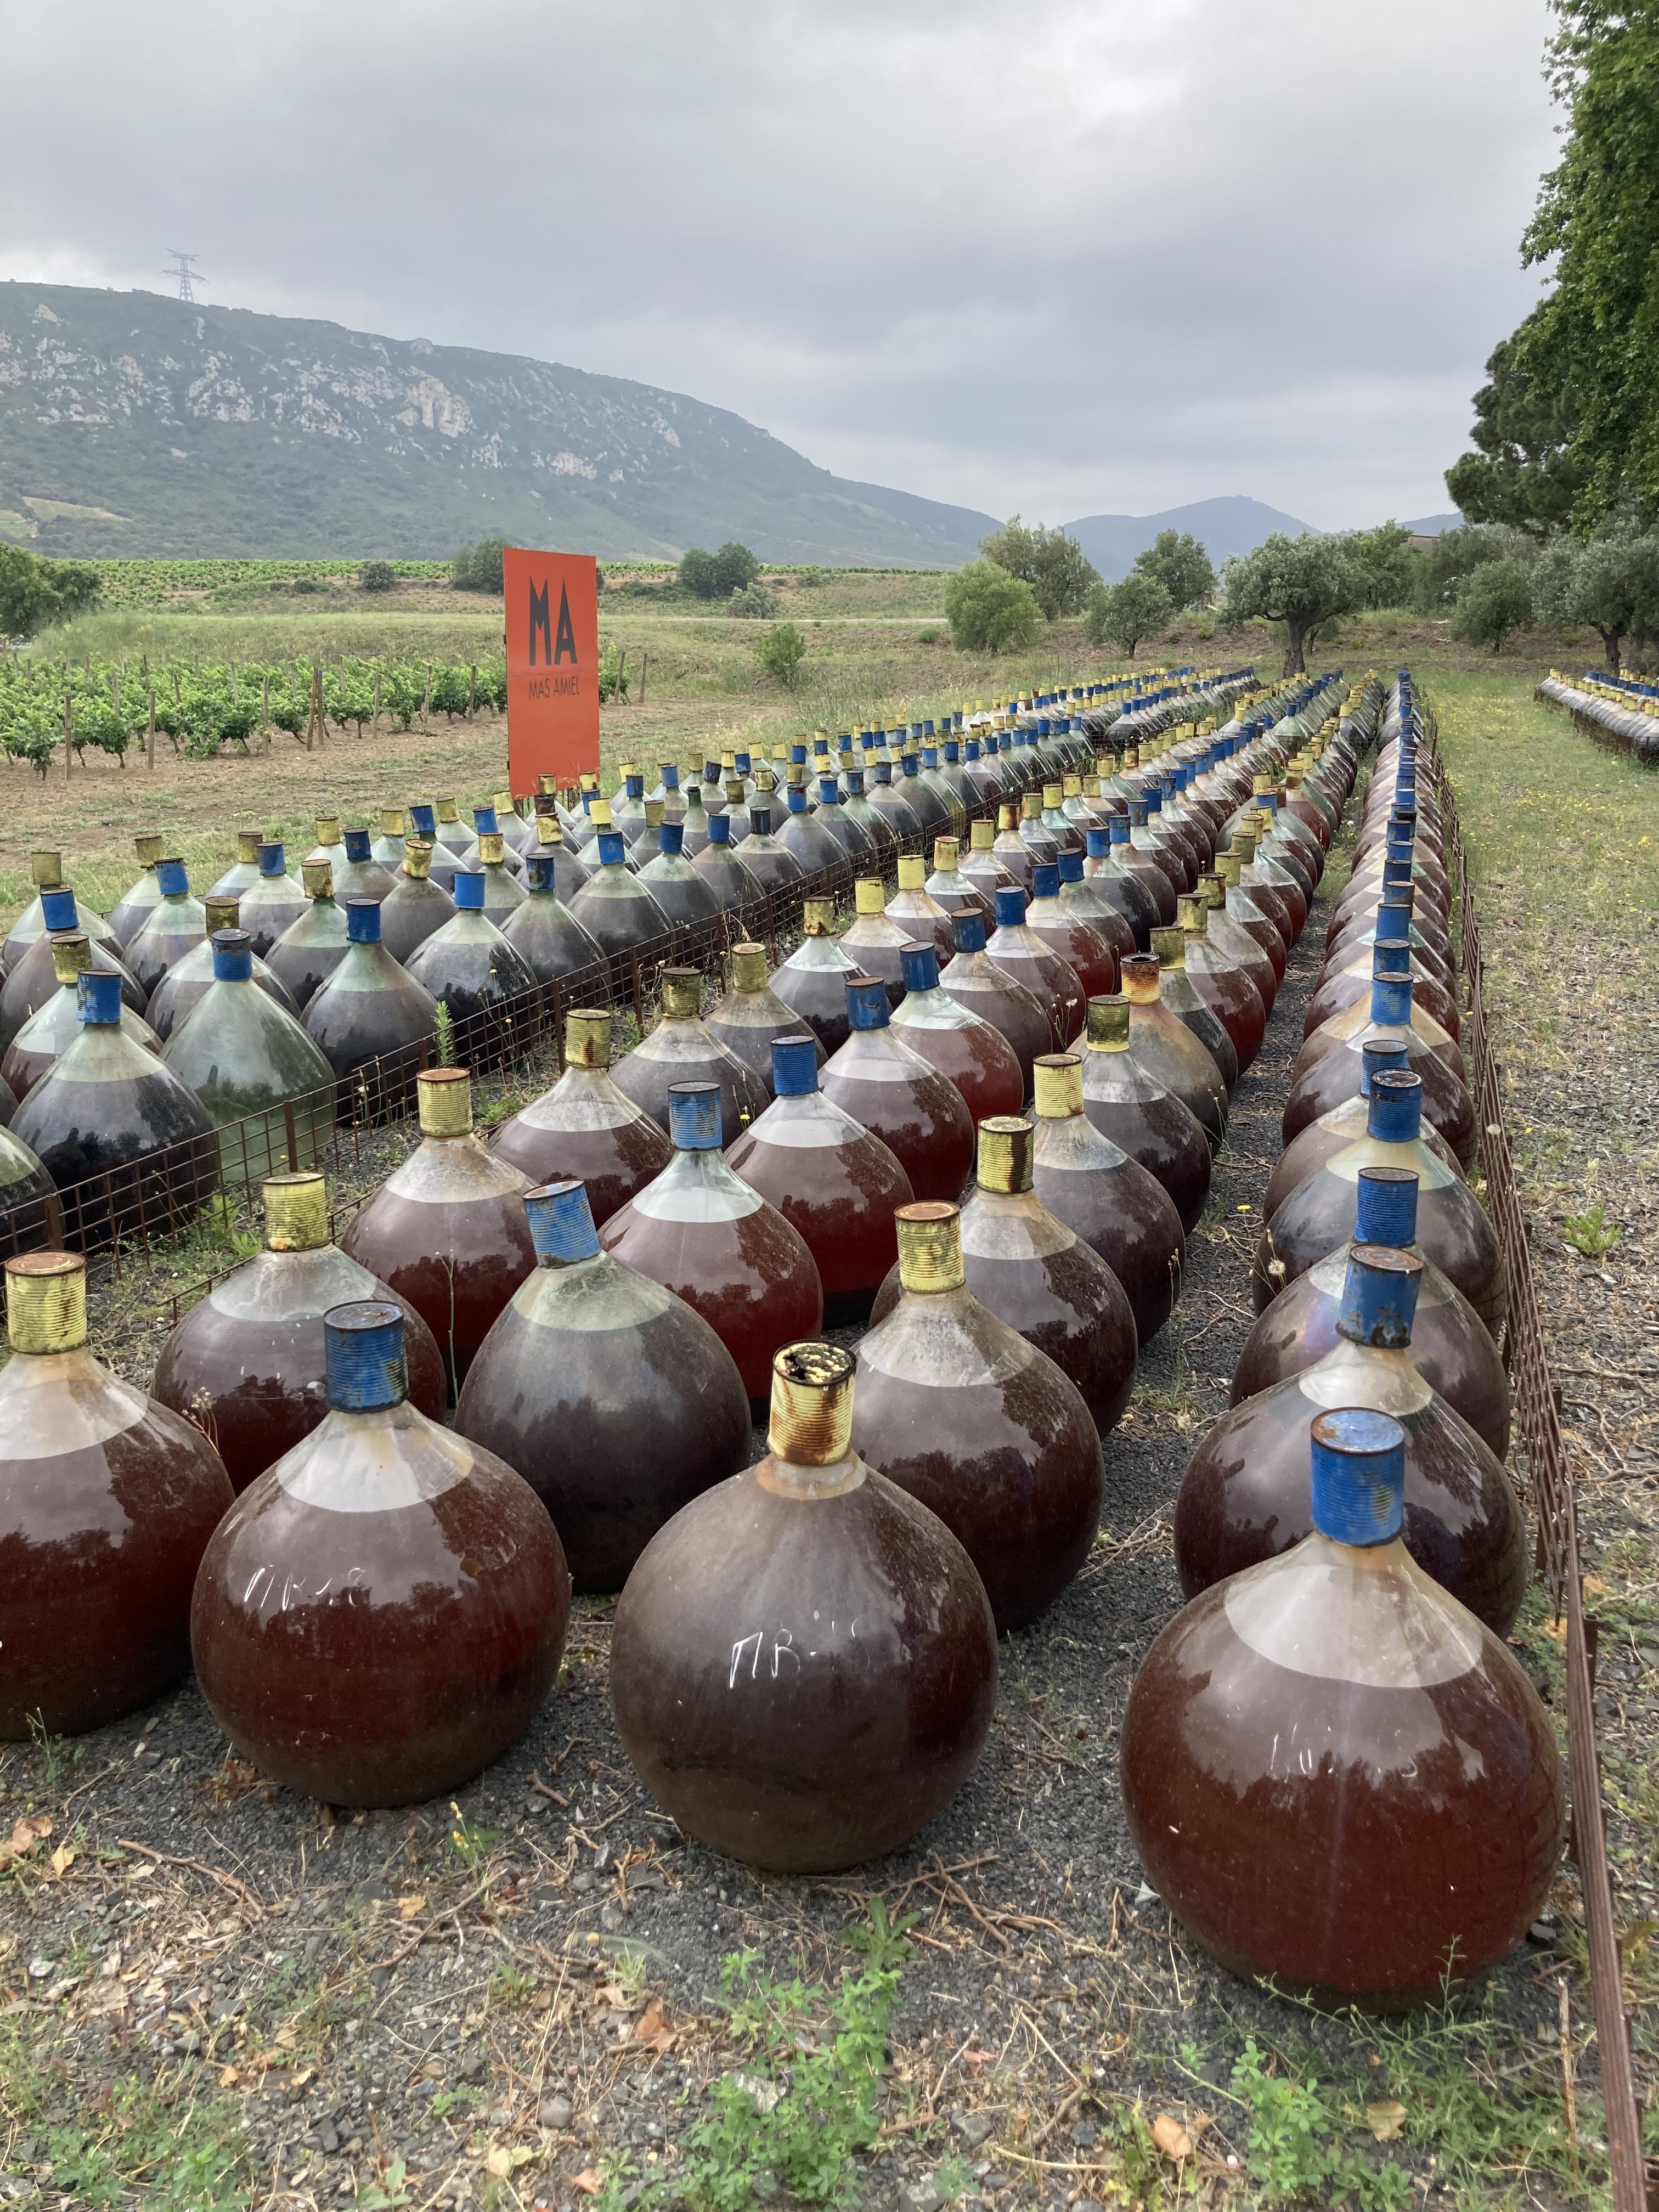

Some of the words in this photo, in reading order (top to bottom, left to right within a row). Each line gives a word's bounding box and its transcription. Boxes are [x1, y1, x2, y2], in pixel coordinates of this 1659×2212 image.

[529, 575, 578, 666] MA
[529, 678, 550, 699] MAS
[554, 676, 580, 697] AMIEL
